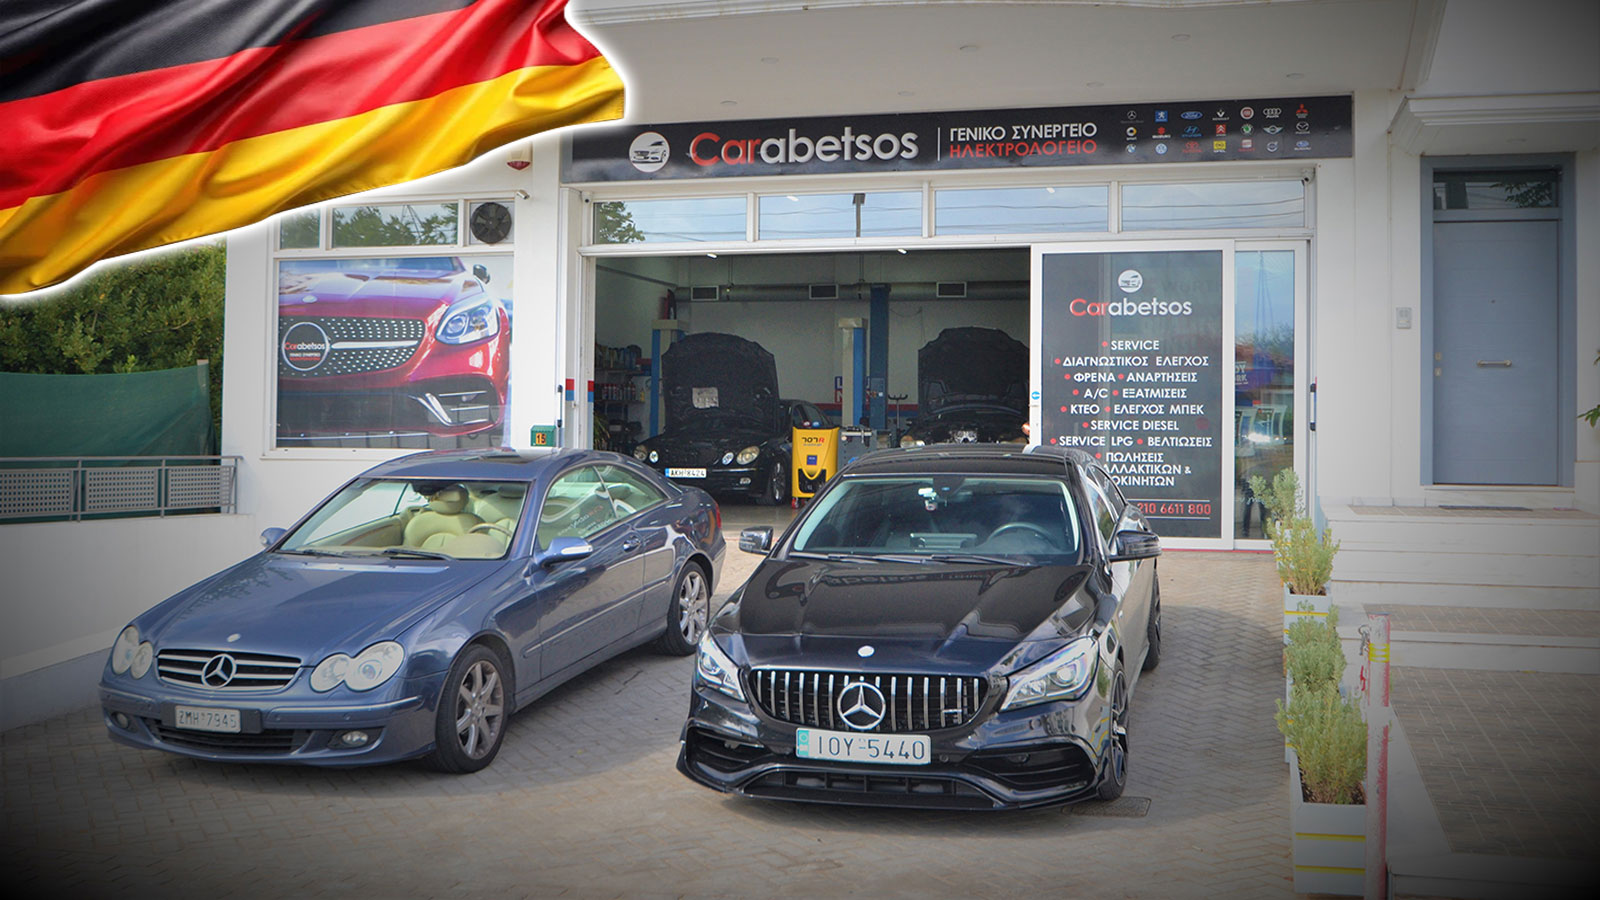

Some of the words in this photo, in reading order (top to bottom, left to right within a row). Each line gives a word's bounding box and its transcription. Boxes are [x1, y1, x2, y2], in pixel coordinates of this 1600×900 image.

[950, 127, 1006, 142] ΓΕΝΙΚΟ
[1011, 122, 1098, 140] ΣΥΝΕΡΓΕΙΟ
[689, 126, 919, 167] Carabetsos
[949, 139, 1098, 158] ΗΛΕΚΤΡΟΛΟΓΕΙΟ
[1069, 298, 1193, 317] Carabetsos
[1111, 340, 1160, 351] SERVICE
[1063, 356, 1149, 367] ΔΙΑΓΝΩΣΤΙΚΟΣ
[1156, 356, 1209, 366] ΕΛΕΓΧΟΣ
[1073, 372, 1116, 383] ΦΡΕΝΑ
[1126, 372, 1198, 383] ΑΝΑΡΤΗΣΕΙΣ
[1084, 388, 1109, 399] A/C
[1122, 388, 1187, 399] ΕΞΑΤΜΙΣΕΙΣ
[1070, 404, 1100, 415] ΚΤΕΟ
[1114, 404, 1164, 415] ΕΛΕΓΧΟΣ
[1170, 404, 1204, 415] ΜΠΕΚ
[1090, 420, 1139, 431] SERVICE
[1143, 420, 1179, 431] DIESEL
[1059, 436, 1106, 447] SERVICE
[1111, 436, 1133, 447] LPG
[1147, 436, 1213, 447] ΒΕΛΤΙΩΣΕΙΣ
[1106, 452, 1164, 463] ΠΩΛΗΣΕΙΣ
[1104, 464, 1181, 474] ΑΛΛΑΚΤΙΚΩΝ
[1184, 466, 1192, 474] &
[1112, 476, 1175, 486] ΟΚΙΝΗΤΩΝ
[1160, 503, 1184, 514] 6611
[1188, 503, 1212, 514] 800
[207, 712, 237, 728] 7945
